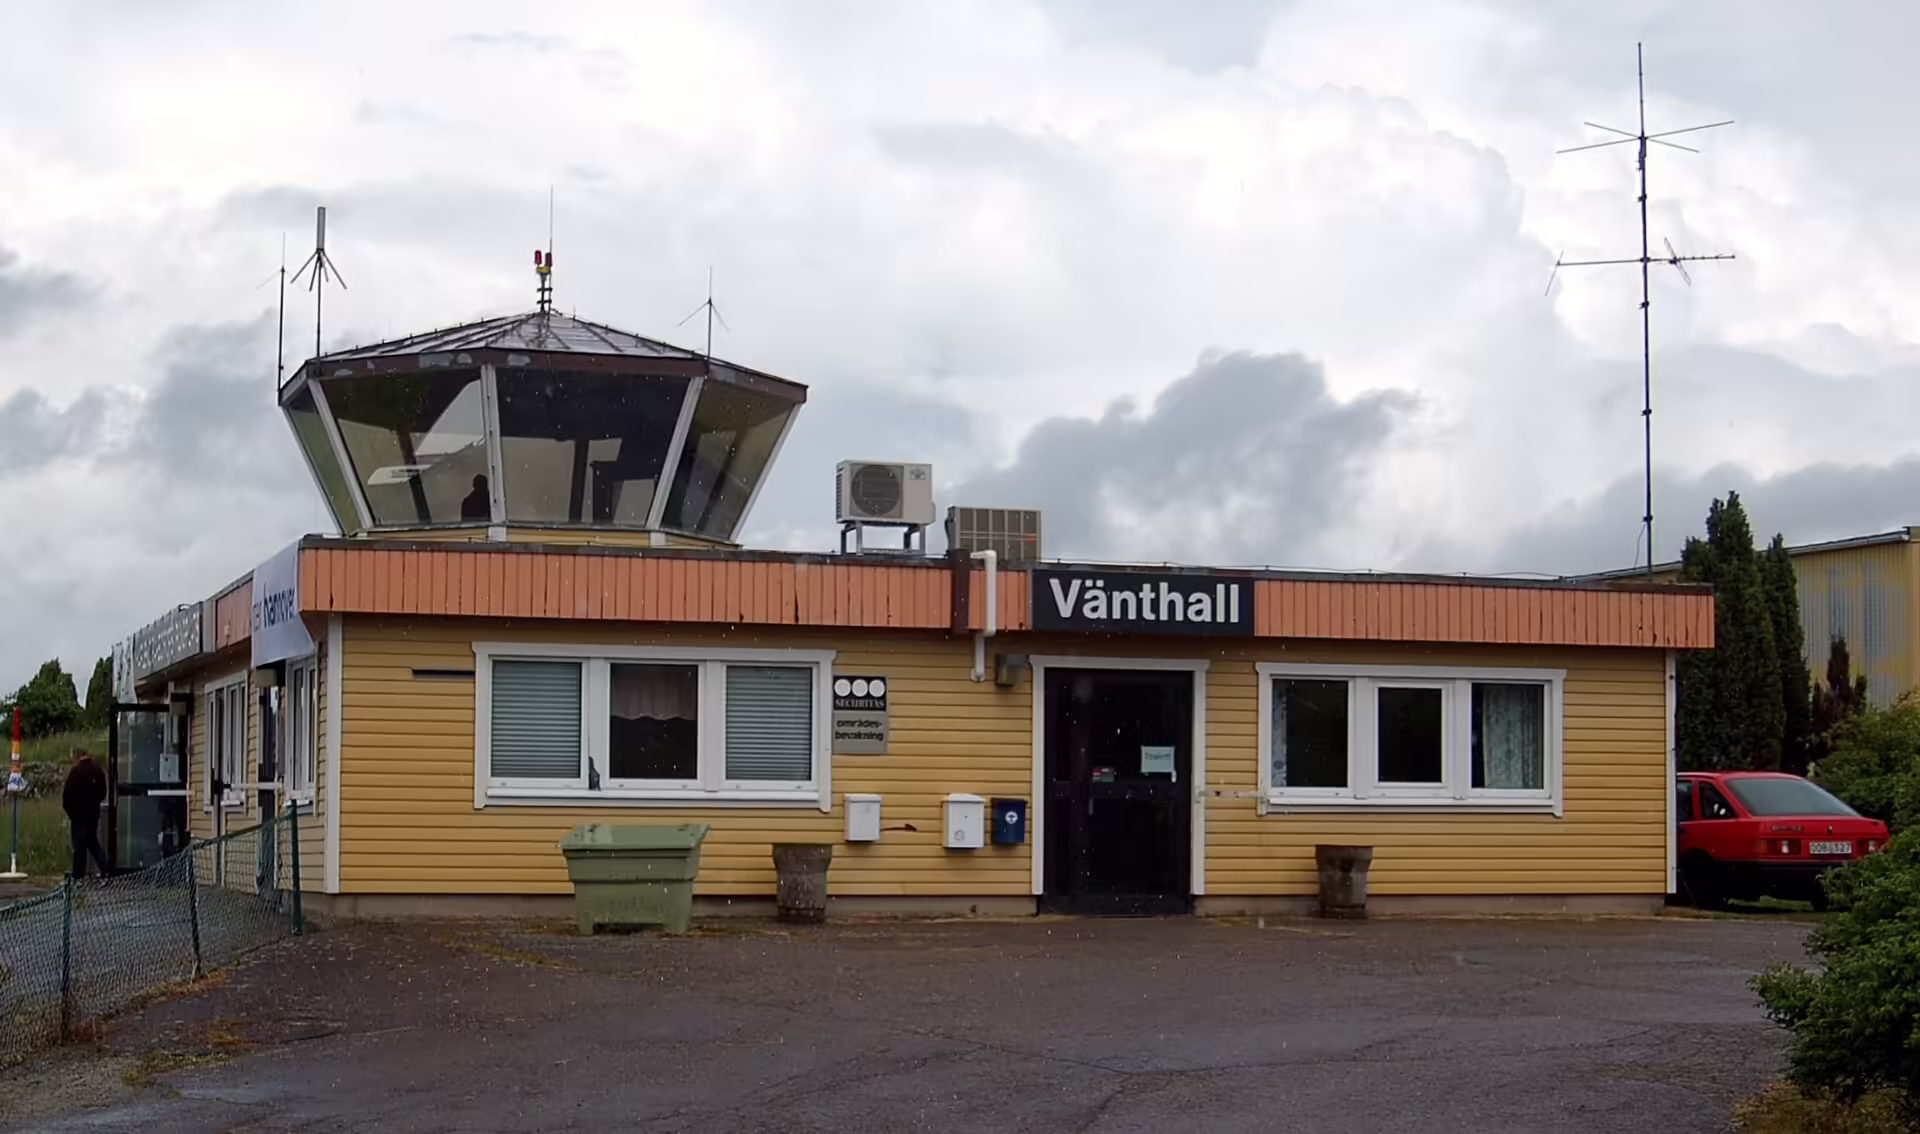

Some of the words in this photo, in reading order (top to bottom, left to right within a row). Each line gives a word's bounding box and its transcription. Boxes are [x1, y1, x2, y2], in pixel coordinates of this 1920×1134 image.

[1049, 578, 1239, 623] Vänthall
[835, 698, 884, 708] SECURITAS
[836, 718, 882, 728] områdes-
[835, 731, 884, 742] bevakning
